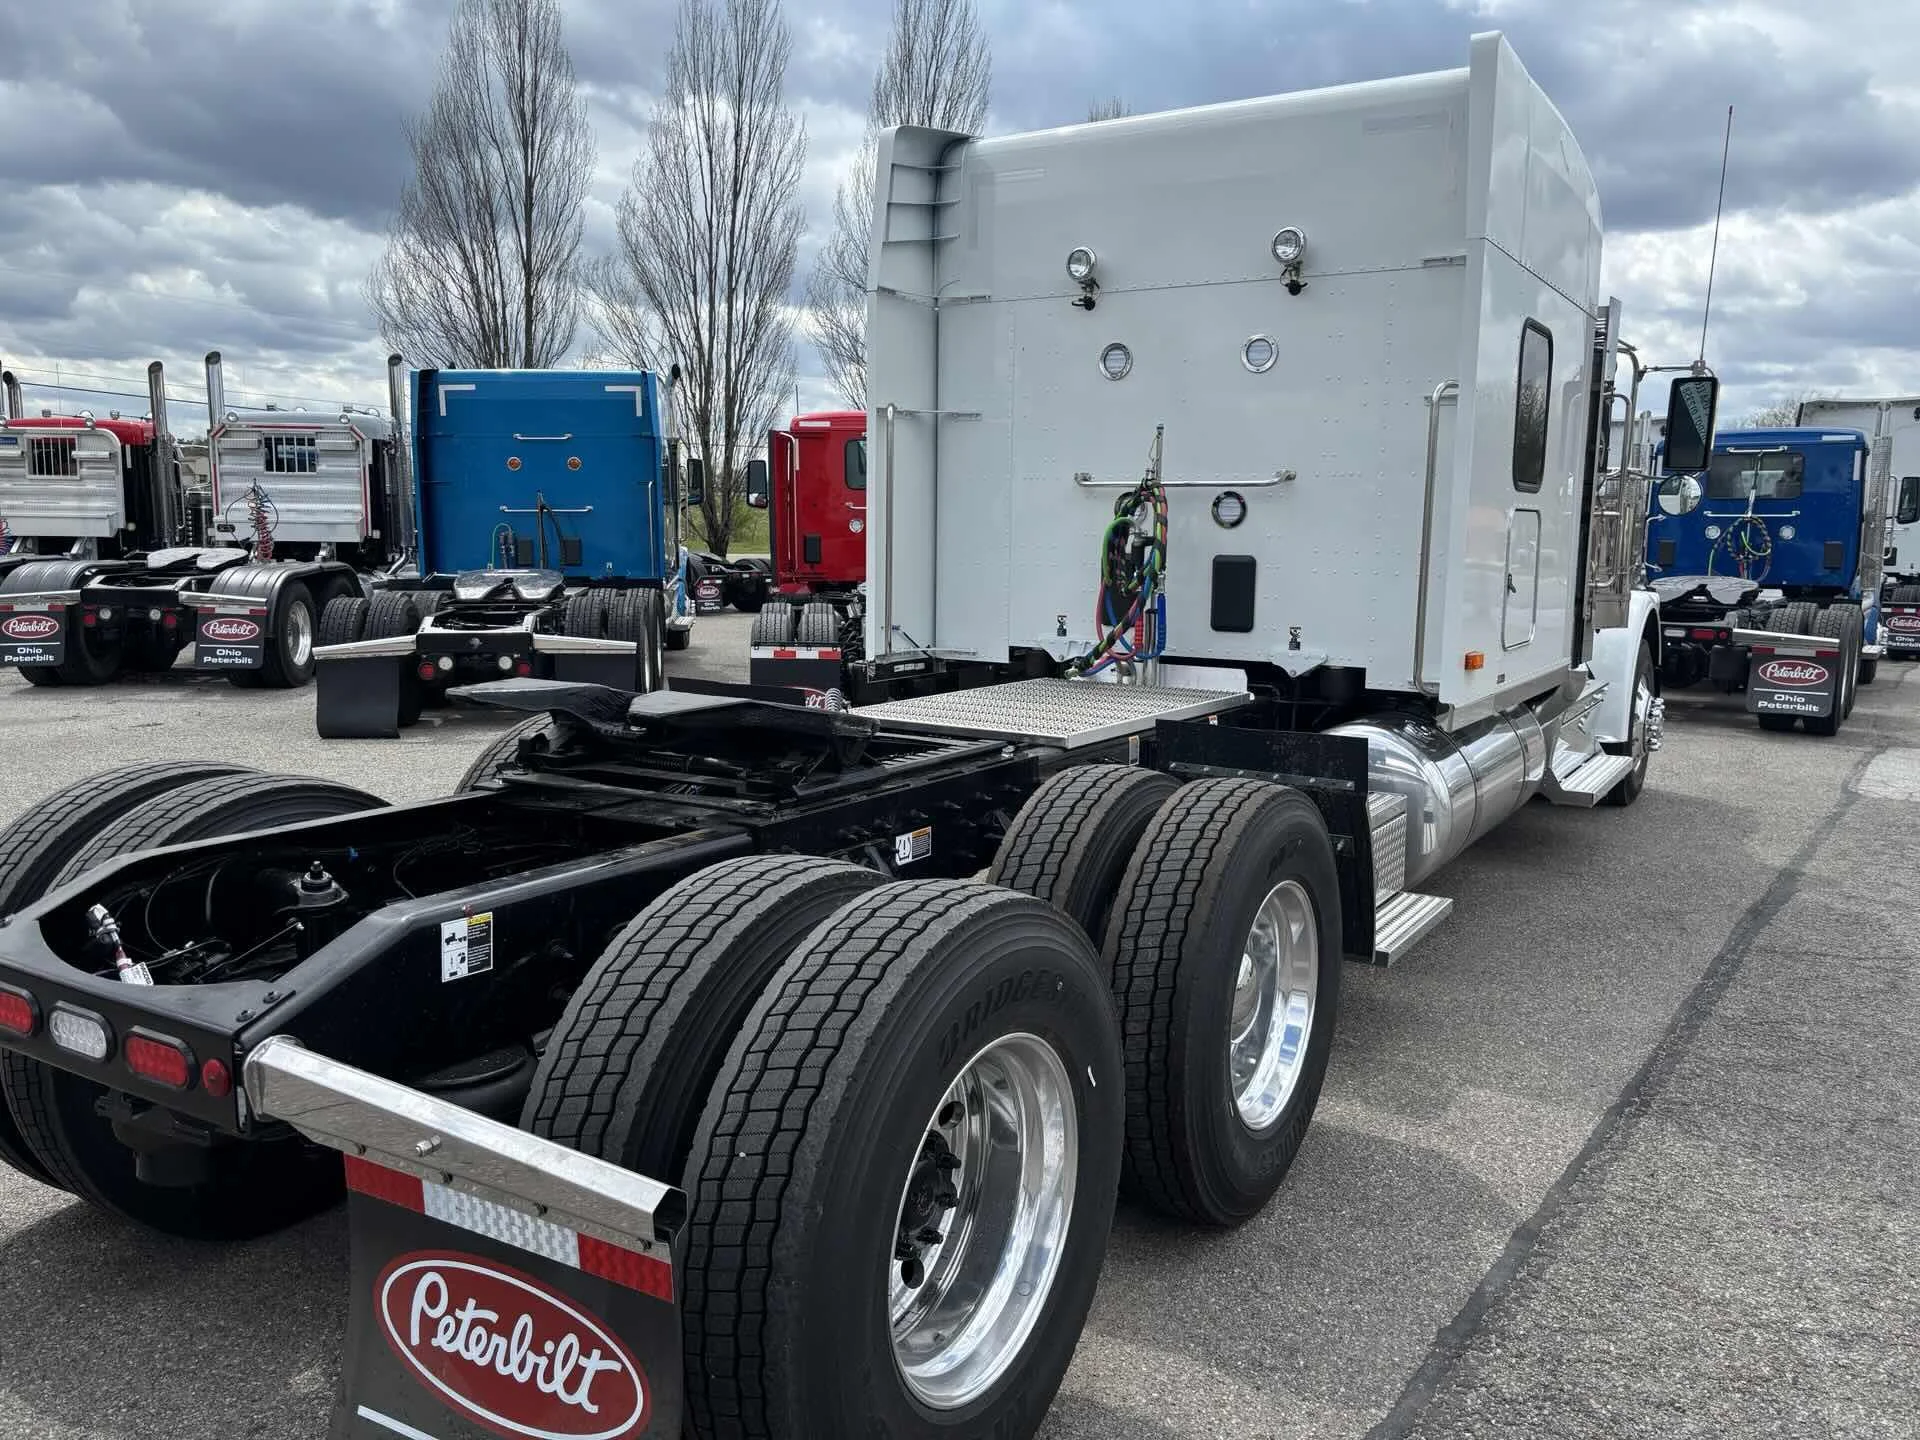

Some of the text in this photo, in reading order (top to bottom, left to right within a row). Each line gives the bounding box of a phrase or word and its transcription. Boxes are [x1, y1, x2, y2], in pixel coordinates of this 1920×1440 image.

[203, 656, 253, 664] Peterbilt
[1766, 663, 1823, 680] Peterbilt
[1774, 694, 1806, 703] Ohio
[1757, 700, 1820, 712] Peterbilt
[410, 1271, 622, 1414] Peterbilt
